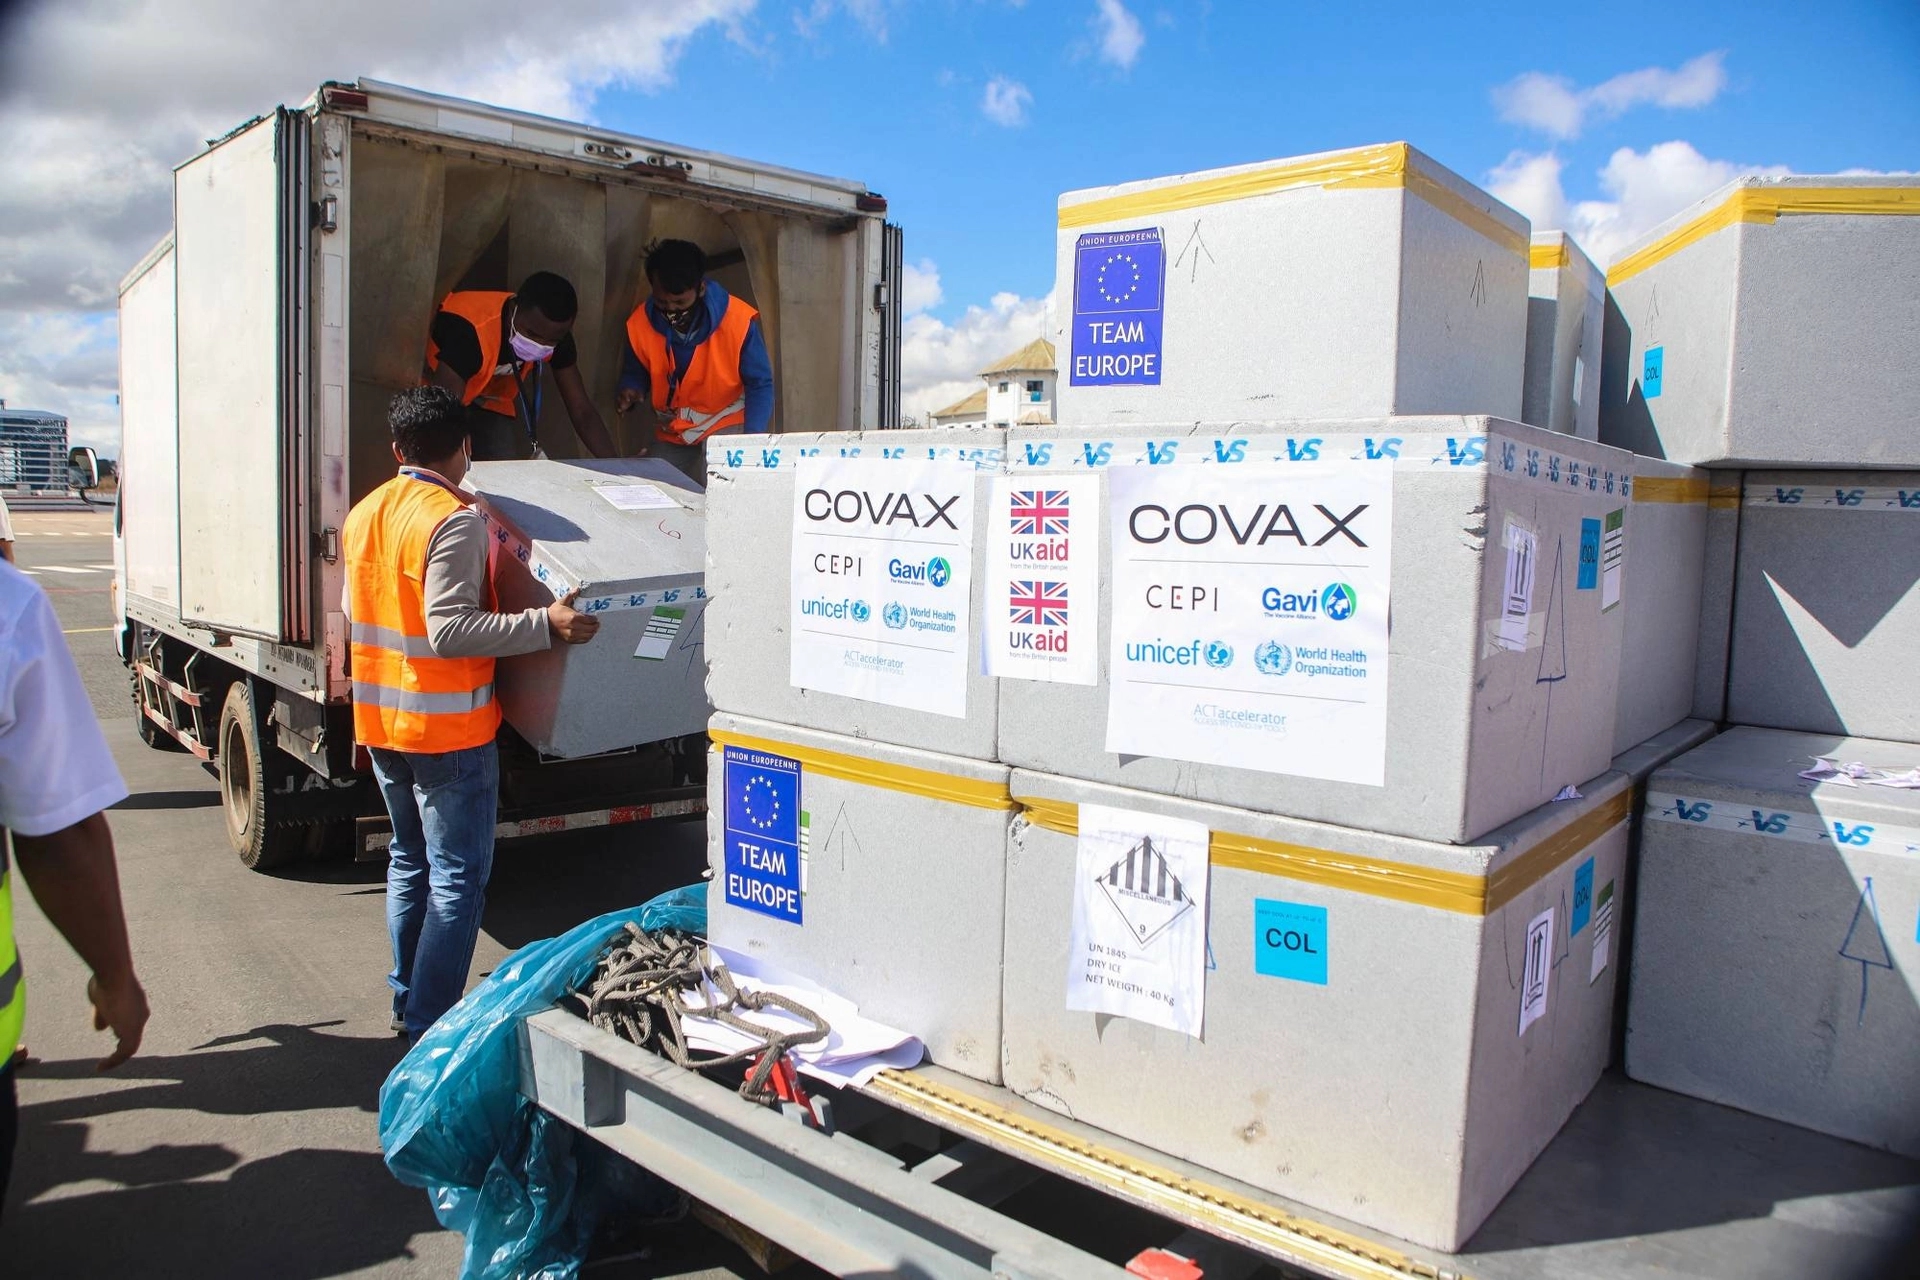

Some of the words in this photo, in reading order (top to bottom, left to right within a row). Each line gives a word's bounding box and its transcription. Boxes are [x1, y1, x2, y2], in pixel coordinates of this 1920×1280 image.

[1080, 236, 1105, 246] UNION
[1108, 231, 1159, 244] EUROPEENN
[1089, 321, 1144, 344] TEAM
[1076, 354, 1156, 377] EUROPE
[727, 449, 744, 468] VS
[762, 449, 781, 468] VS
[1025, 443, 1053, 466] VS
[1083, 442, 1114, 467] VS
[1147, 441, 1178, 465] VS
[1214, 439, 1248, 463] VS
[1286, 438, 1323, 461] VS
[1364, 437, 1403, 460] VS
[1446, 436, 1487, 466] VS
[1776, 487, 1804, 504] VS
[1835, 489, 1865, 507] VS
[804, 488, 960, 530] COVAX
[1128, 504, 1370, 548] COVAX
[814, 553, 861, 577] CEPI
[889, 558, 925, 581] Gavi
[802, 596, 849, 619] unicef
[1146, 585, 1218, 611] CEPI
[1262, 587, 1317, 612] Gavi
[909, 618, 956, 633] Organization
[910, 607, 931, 618] World
[933, 609, 956, 622] Health
[1126, 638, 1200, 666] unicef
[1295, 646, 1327, 660] World
[1331, 649, 1367, 663] Health
[1295, 661, 1367, 678] Organization
[726, 750, 749, 762] UNION
[751, 754, 797, 771] EUROPEENNE
[1676, 799, 1712, 822] VS
[1751, 810, 1790, 834] VS
[1833, 821, 1875, 846] VS
[738, 842, 786, 876] TEAM
[729, 874, 798, 914] EUROPE
[1139, 924, 1146, 935] 9
[1266, 928, 1317, 954] COL
[1088, 942, 1104, 953] UN
[1106, 946, 1127, 960] 1845
[1087, 958, 1107, 969] DRY
[1109, 963, 1122, 974] ICE
[1085, 973, 1105, 985] NET
[1107, 977, 1143, 995] WEIGTH
[1150, 988, 1161, 1001] 40
[1163, 993, 1175, 1007] Kg
